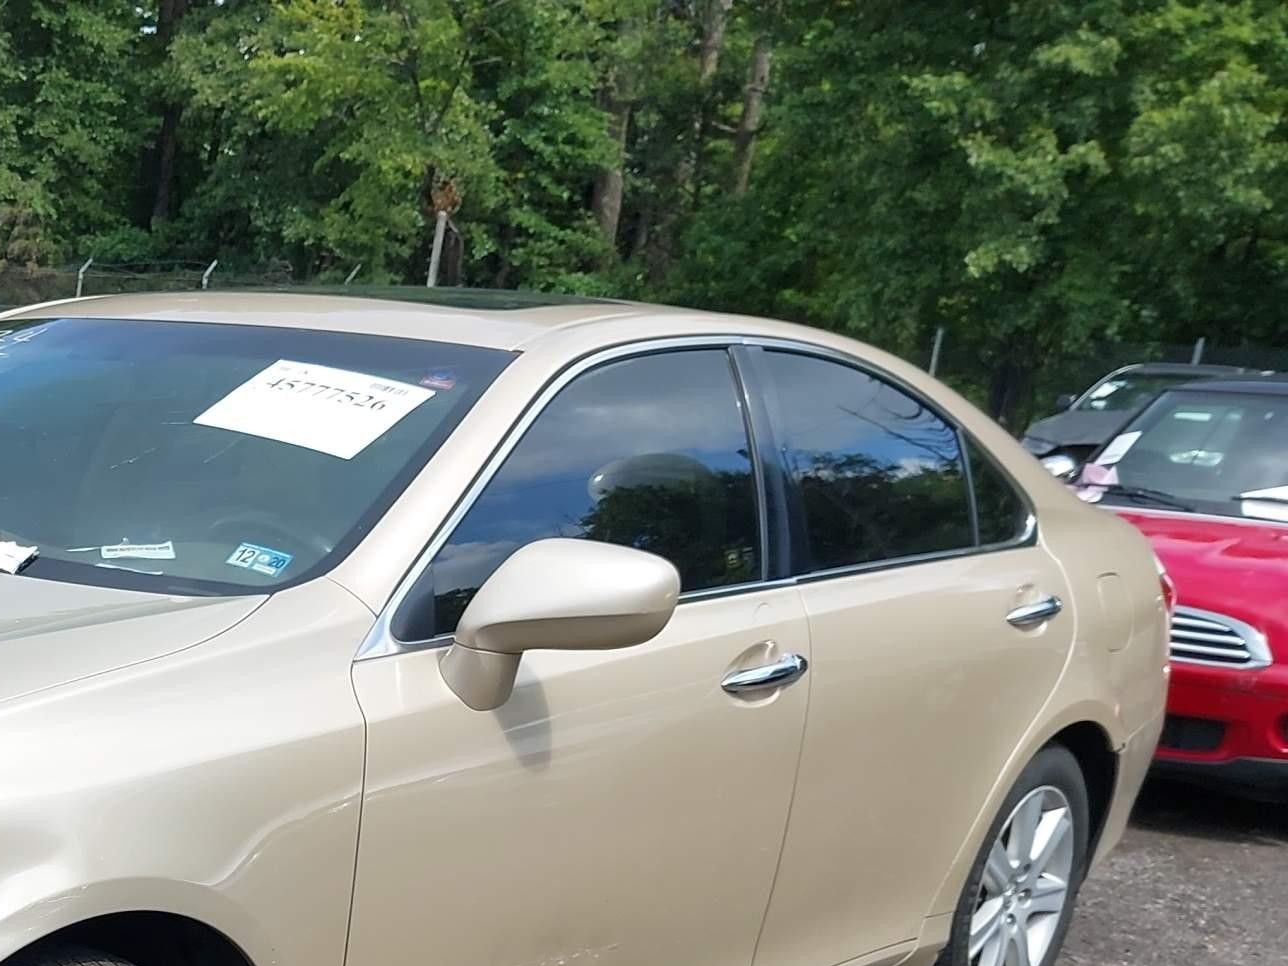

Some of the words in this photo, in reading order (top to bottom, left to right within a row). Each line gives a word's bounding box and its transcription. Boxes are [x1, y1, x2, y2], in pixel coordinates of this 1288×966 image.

[266, 377, 387, 411] 45777526
[236, 548, 256, 564] 12
[267, 556, 286, 569] 20
